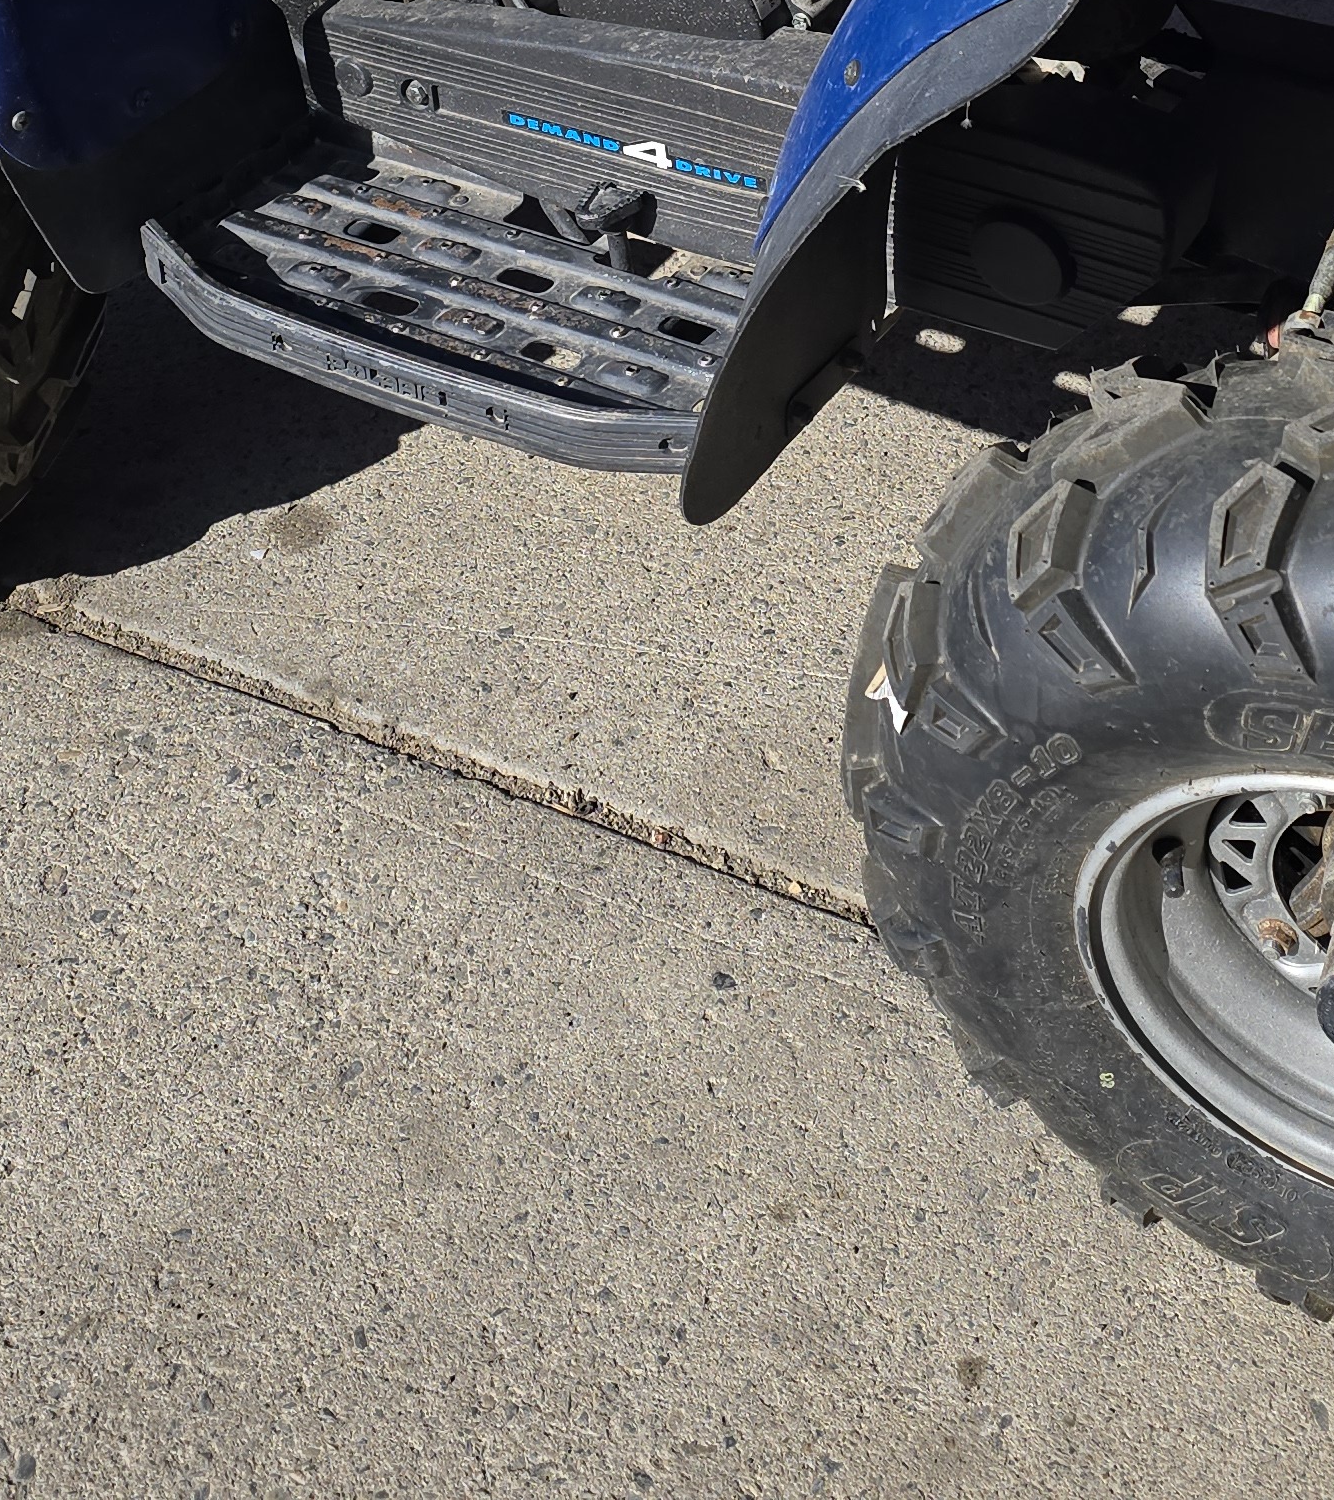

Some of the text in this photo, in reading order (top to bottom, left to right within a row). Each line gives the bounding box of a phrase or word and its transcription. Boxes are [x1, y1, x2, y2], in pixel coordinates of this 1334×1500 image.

[508, 112, 759, 189] DEMAND 4 DRIVE
